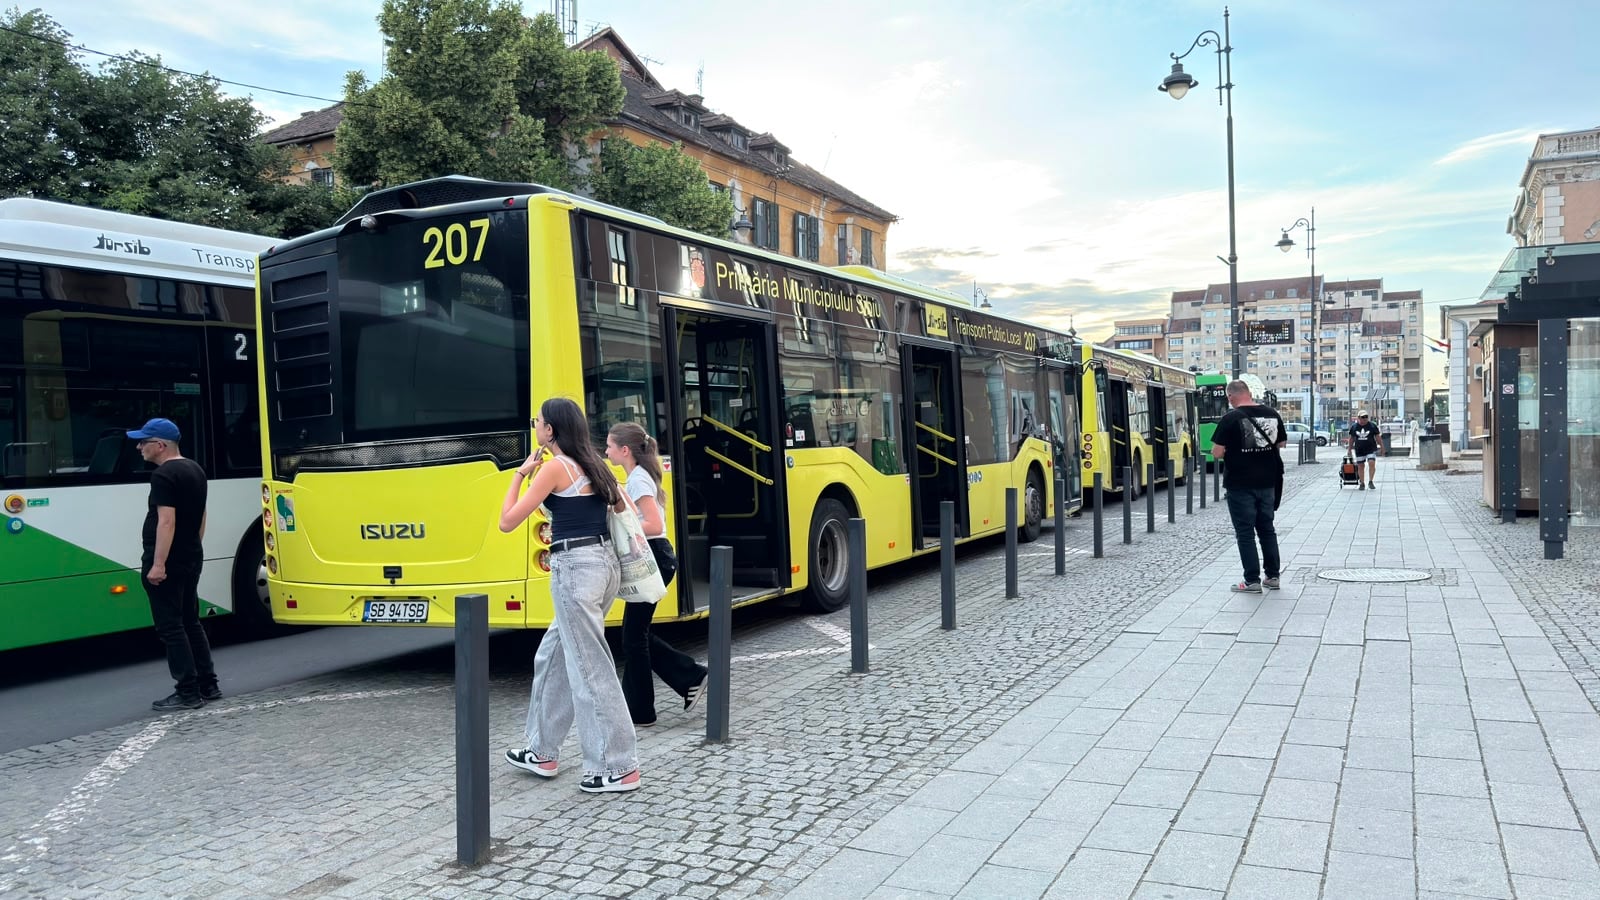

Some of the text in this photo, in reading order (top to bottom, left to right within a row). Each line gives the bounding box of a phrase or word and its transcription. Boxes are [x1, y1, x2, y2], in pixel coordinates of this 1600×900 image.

[422, 218, 490, 269] 207
[782, 277, 853, 312] Municipiului
[234, 333, 248, 361] 2
[954, 317, 1037, 352] Transport Public Local 207
[360, 523, 426, 540] ISUZU
[370, 603, 386, 618] SB
